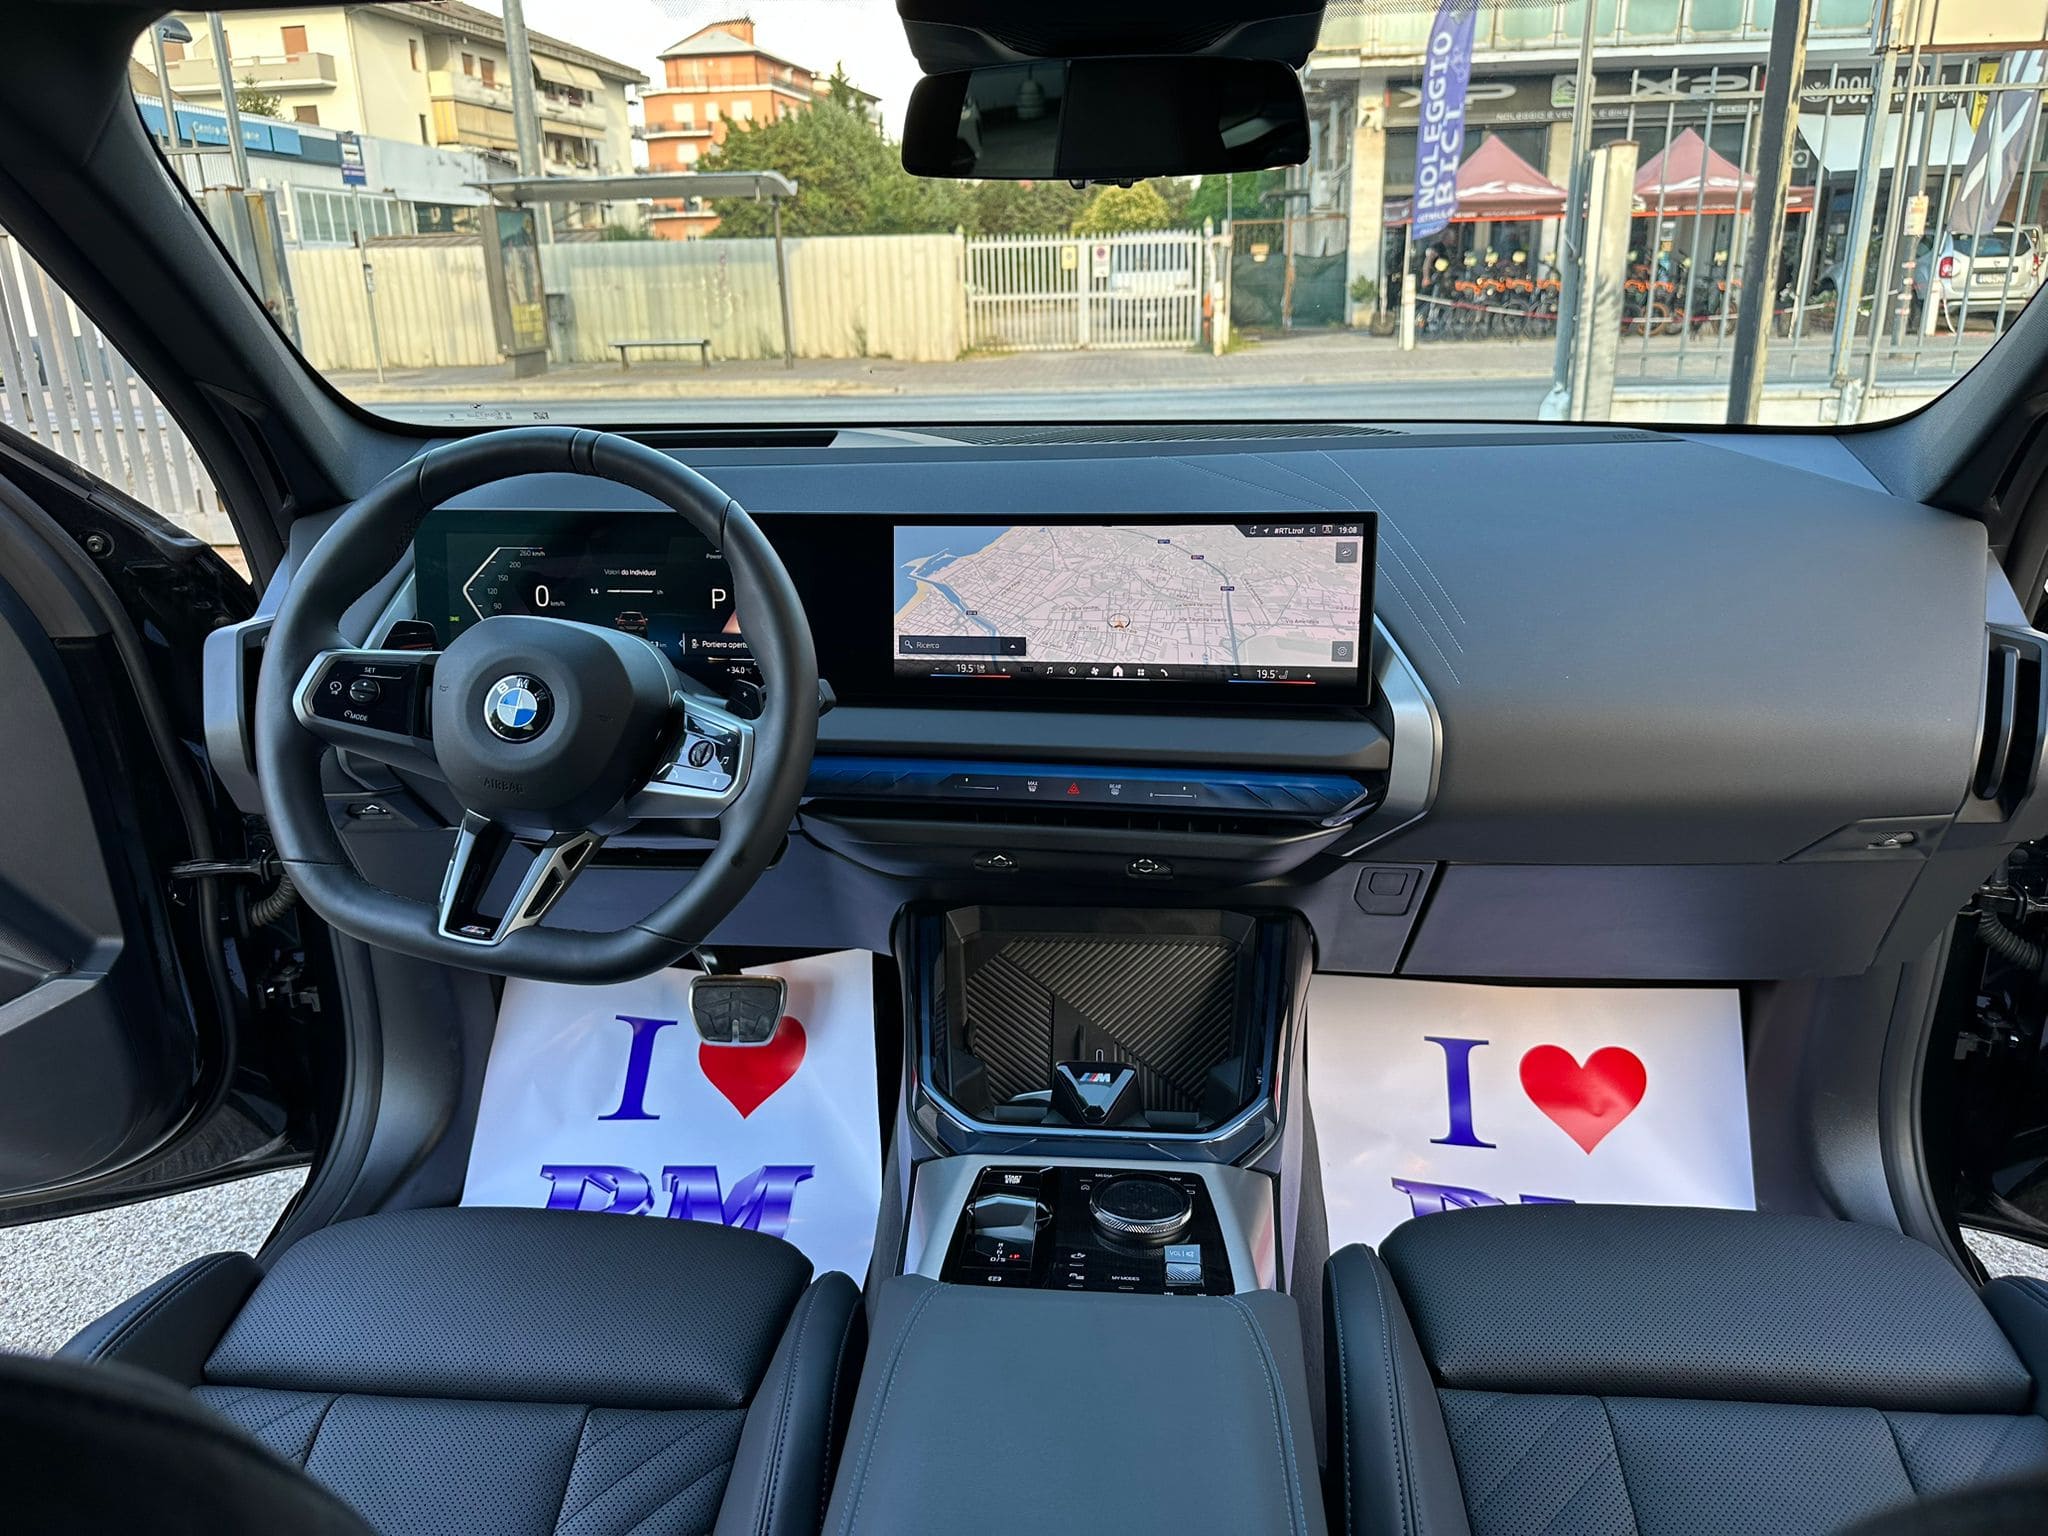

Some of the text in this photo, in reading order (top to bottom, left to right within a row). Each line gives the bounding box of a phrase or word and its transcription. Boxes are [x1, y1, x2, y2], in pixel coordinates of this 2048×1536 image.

[1417, 31, 1453, 209] NOLEGGIO
[1338, 526, 1358, 535] 19:08
[535, 585, 549, 607] 0
[711, 588, 726, 609] P
[364, 666, 376, 674] SET
[350, 713, 368, 721] MODE
[598, 1014, 679, 1121] I
[1423, 1035, 1497, 1149] I
